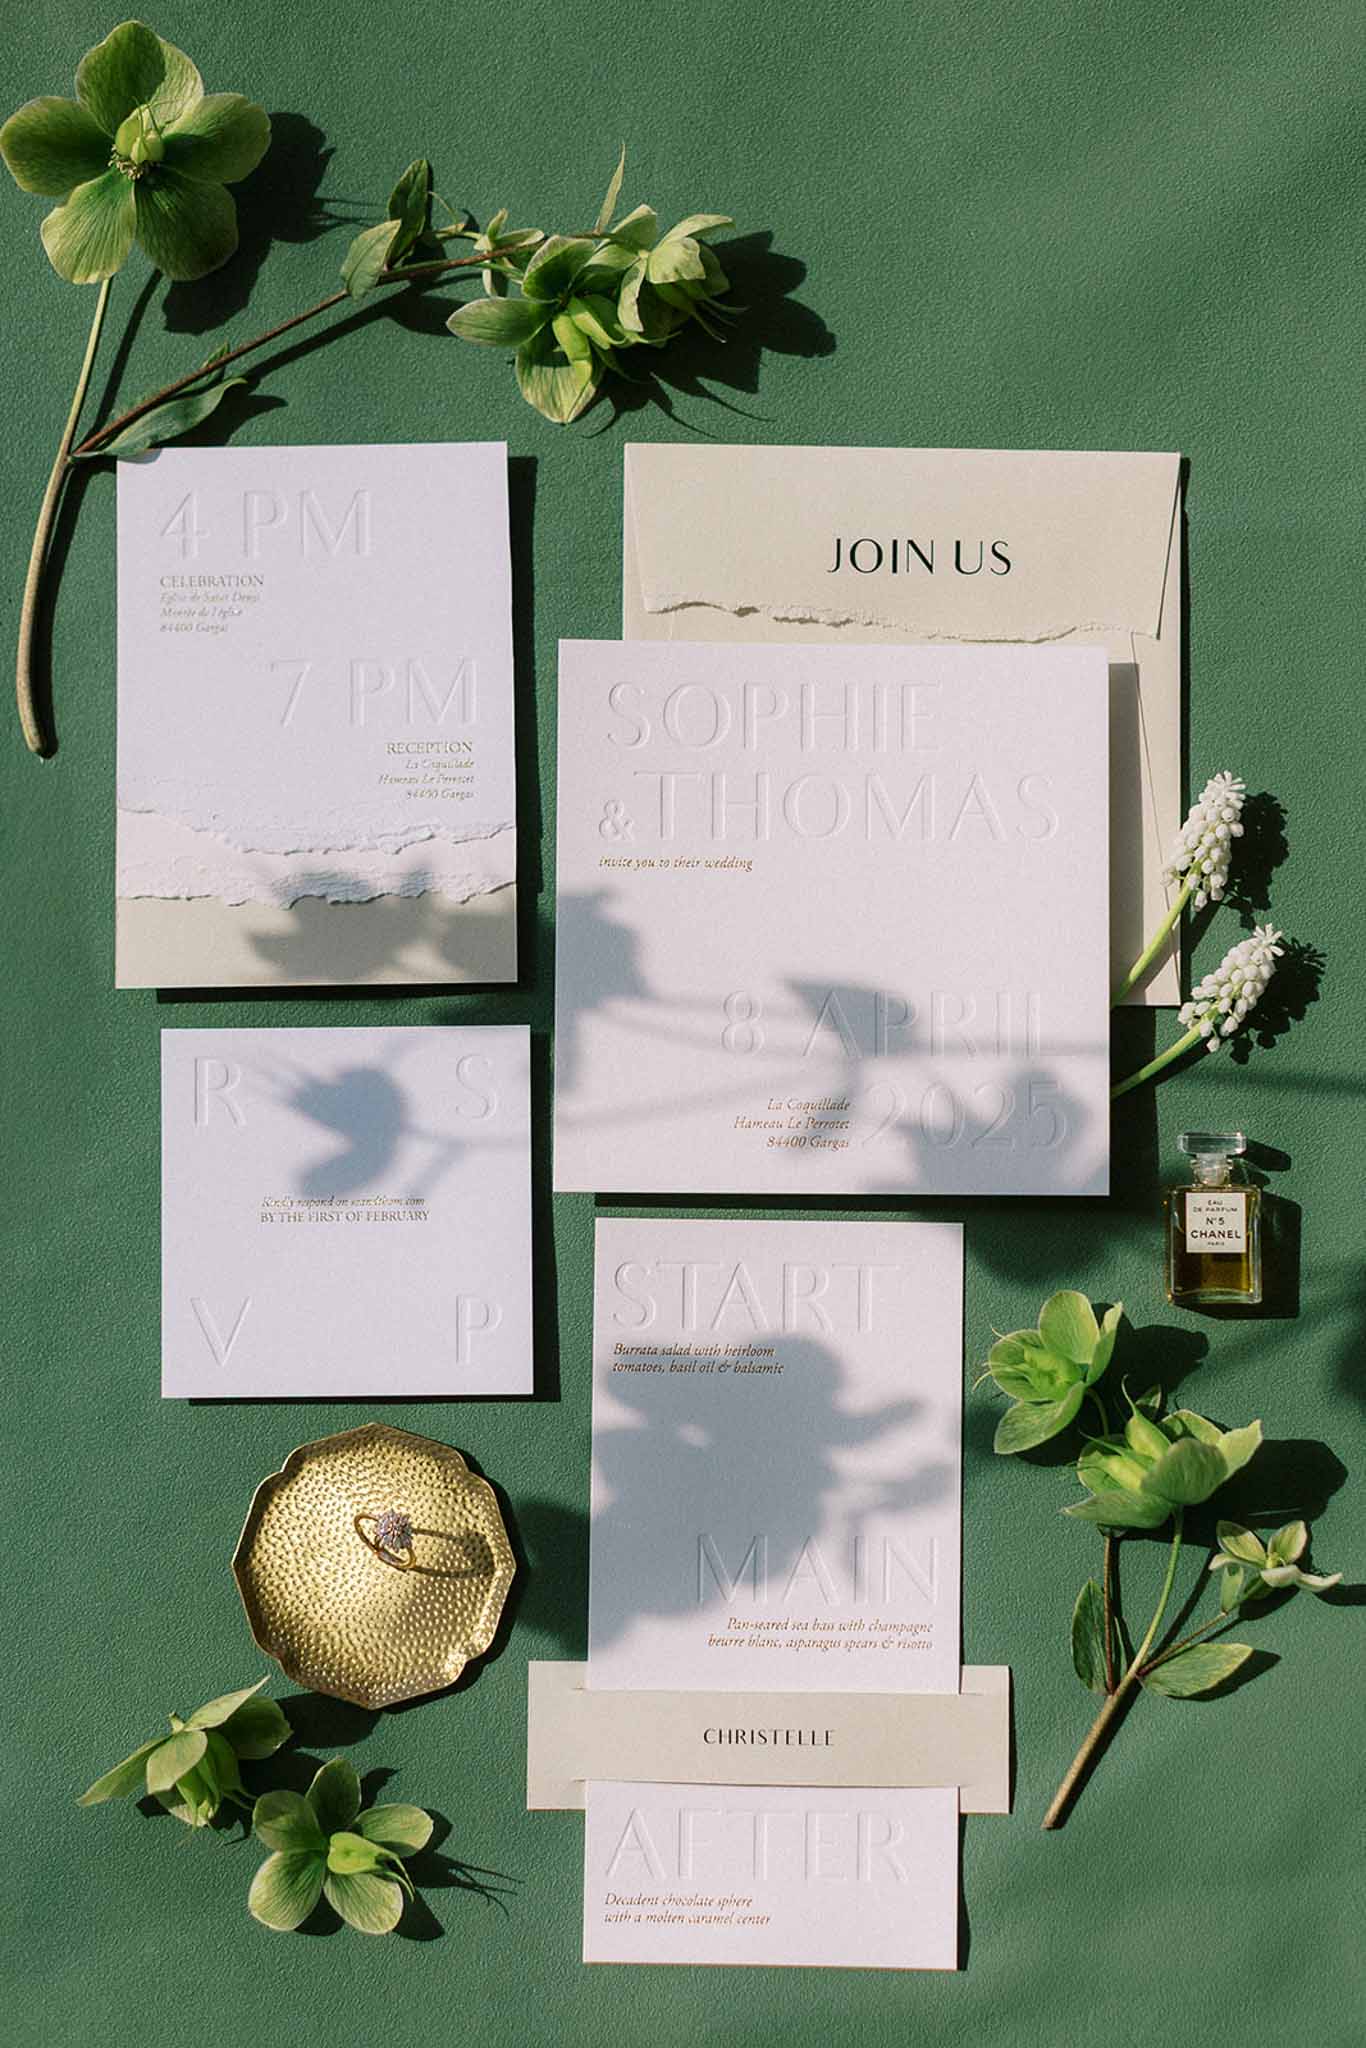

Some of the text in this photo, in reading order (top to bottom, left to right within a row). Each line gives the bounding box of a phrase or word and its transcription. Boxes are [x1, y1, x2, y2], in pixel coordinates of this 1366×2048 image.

[159, 487, 374, 560] 4 PM
[827, 538, 1012, 576] JOIN US
[160, 575, 264, 588] CELEBRATION
[270, 656, 478, 728] 7 PM
[606, 681, 945, 753] SOPHIE
[386, 741, 472, 754] RECEPTION
[405, 760, 418, 769] La
[378, 774, 418, 785] Hameau
[420, 773, 435, 784] Le
[405, 789, 474, 801] 84400 Gargas
[598, 771, 1061, 842] & THOMAS
[599, 856, 753, 873] invite you to their wedding
[720, 990, 1061, 1059] 8 APRIL
[194, 1053, 498, 1127] R S
[767, 1096, 851, 1114] La Coquillade
[734, 1116, 783, 1129] Hameau
[787, 1117, 801, 1129] Le
[862, 1080, 1068, 1151] 2025
[767, 1135, 850, 1152] 84400 Gargas
[261, 1210, 430, 1222] BY THE FIRST OF FEBRUARY
[1190, 1230, 1241, 1239] CHANEL
[612, 1261, 900, 1332] START
[190, 1295, 503, 1368] V P
[613, 1342, 775, 1358] Burrata salad with heirloom
[612, 1360, 784, 1375] tomatoes, basil oil & balsamic
[697, 1533, 938, 1605] MAIN
[727, 1617, 934, 1636] Pan-seared sea bass with champagne
[708, 1633, 934, 1652] beurre blanc, asparagus spears & risotto
[703, 1728, 836, 1746] CHRISTELLE
[605, 1807, 910, 1882] AFTER
[604, 1893, 753, 1910] Decadent chocolate sphere
[604, 1910, 770, 1926] with a molten caramel center
